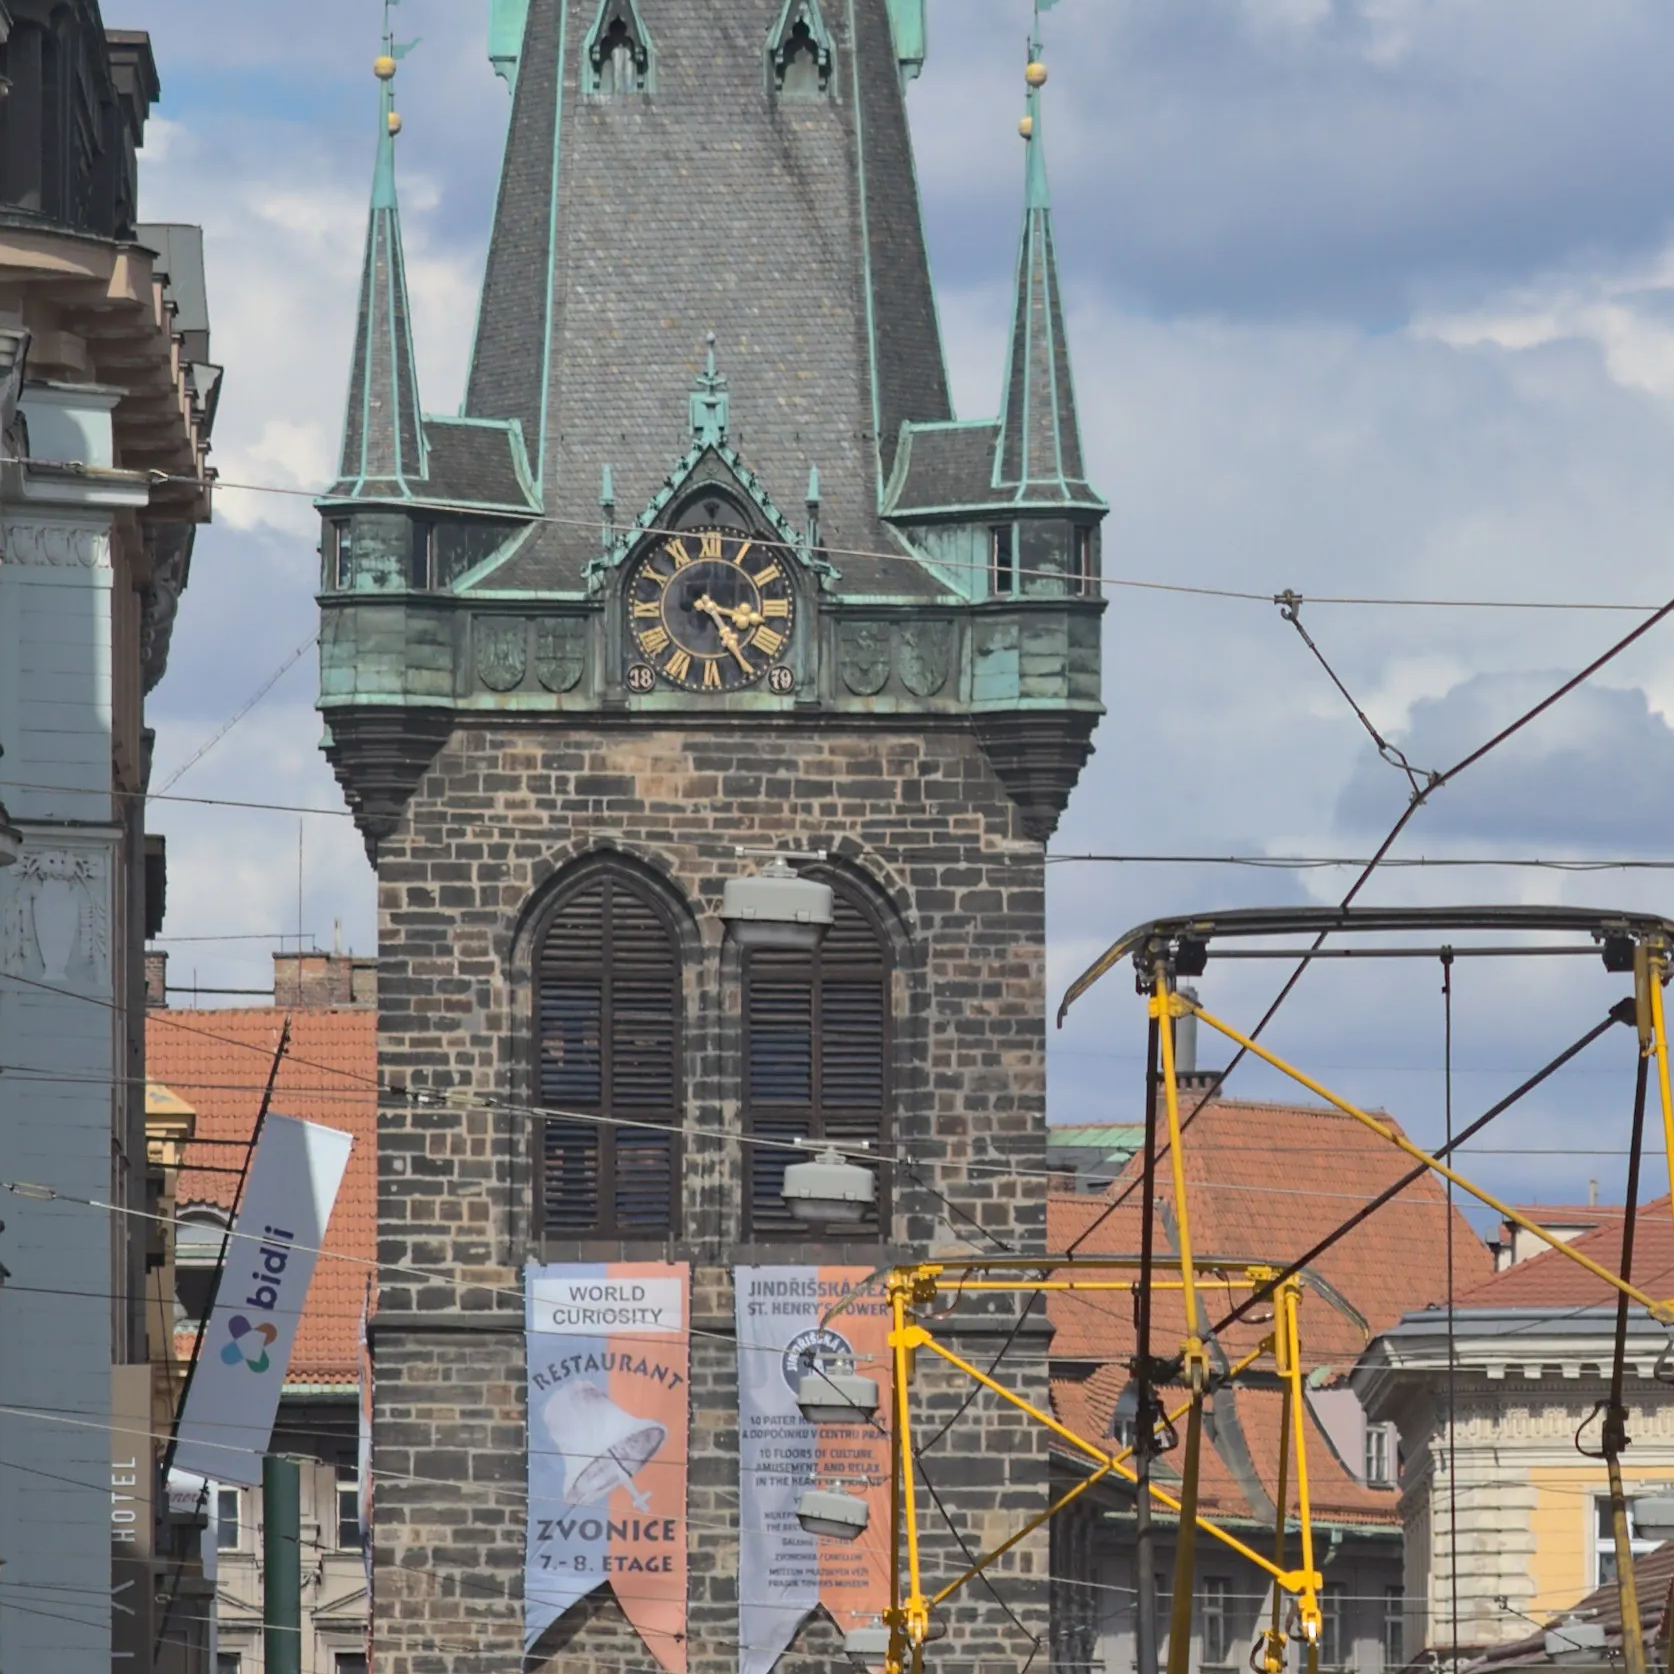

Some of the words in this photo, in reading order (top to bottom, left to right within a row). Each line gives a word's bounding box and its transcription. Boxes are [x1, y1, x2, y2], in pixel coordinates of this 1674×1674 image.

[246, 1225, 295, 1310] bidli
[569, 1286, 645, 1302] WORLD
[748, 1277, 851, 1297] JINDŘIŠSKÁ
[552, 1308, 663, 1325] CURIOSITY
[748, 1302, 767, 1316] ST.
[532, 1353, 684, 1391] RESTAURANT
[111, 1456, 136, 1543] HOTEL
[536, 1519, 676, 1542] ZVONICE
[602, 1556, 673, 1572] ETAGE
